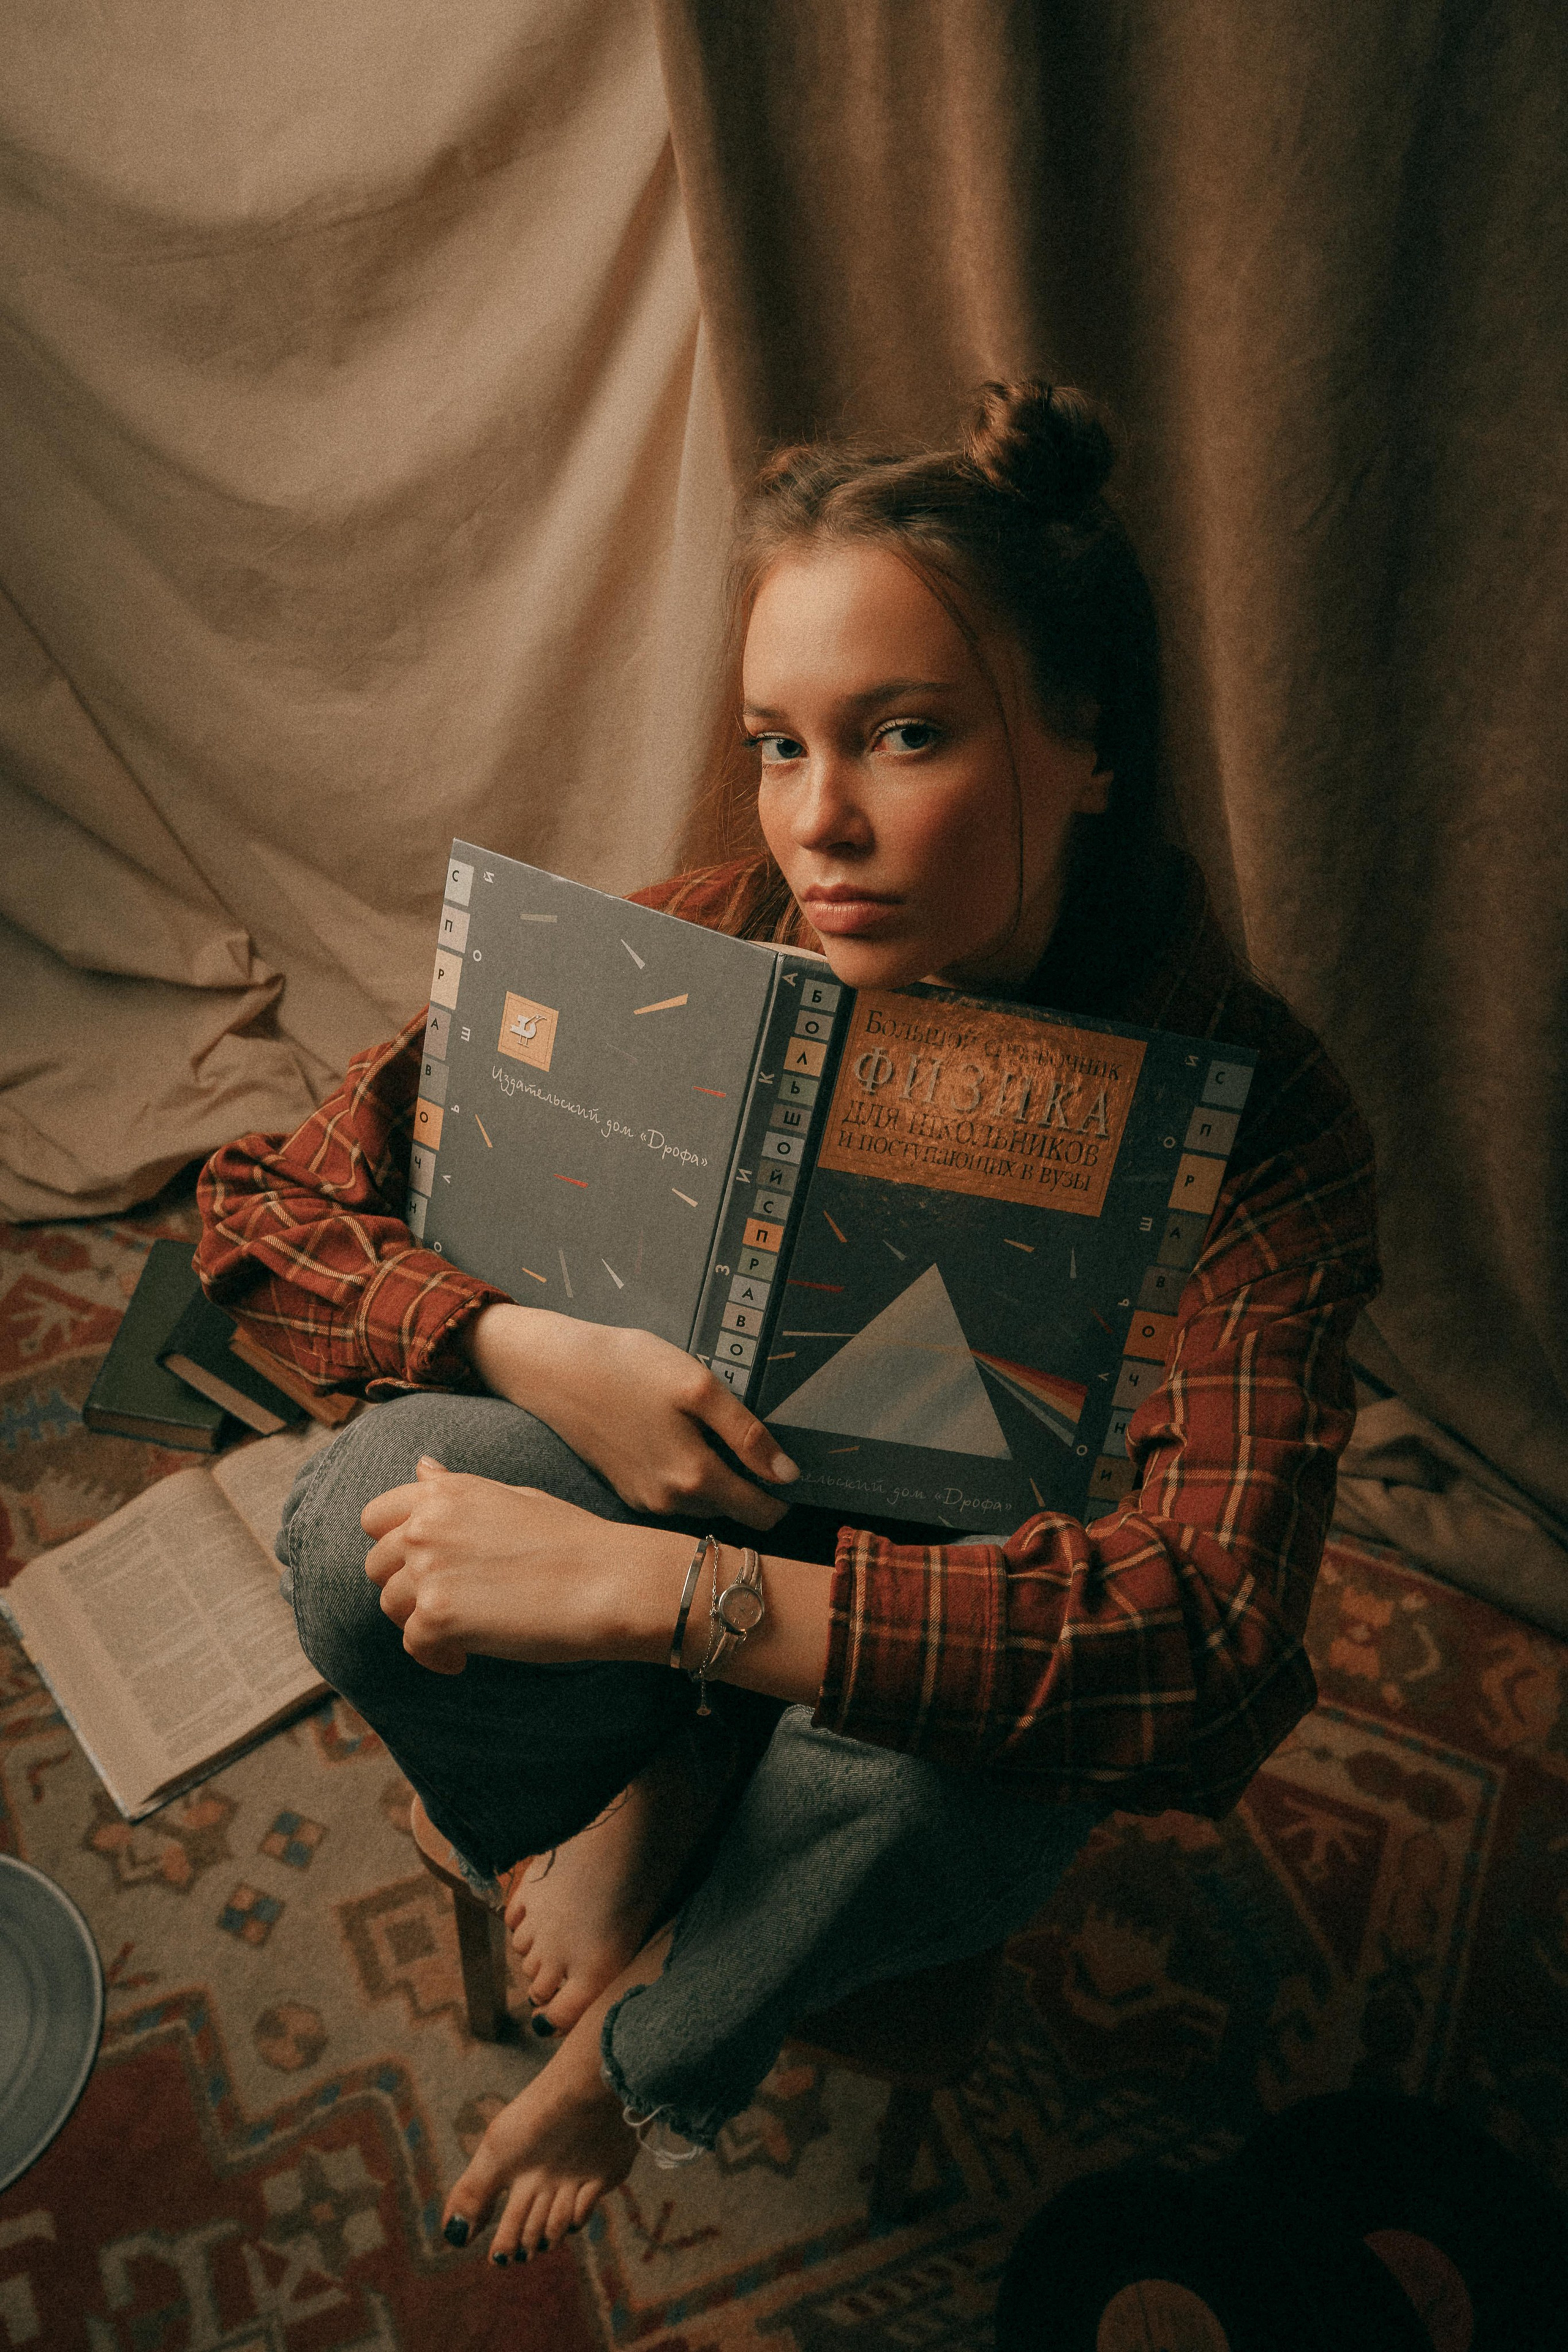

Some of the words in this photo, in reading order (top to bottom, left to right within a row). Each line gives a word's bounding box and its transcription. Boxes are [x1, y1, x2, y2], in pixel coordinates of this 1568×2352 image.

[492, 1066, 600, 1123] Издательский
[601, 1120, 633, 1137] дом
[640, 1129, 708, 1166] «Дрофа»
[854, 1046, 1109, 1139] ФИЗИКА
[1088, 1072, 1225, 1521] СПРАВОЧНИ
[799, 1473, 885, 1494] ельский
[887, 1486, 927, 1505] дом
